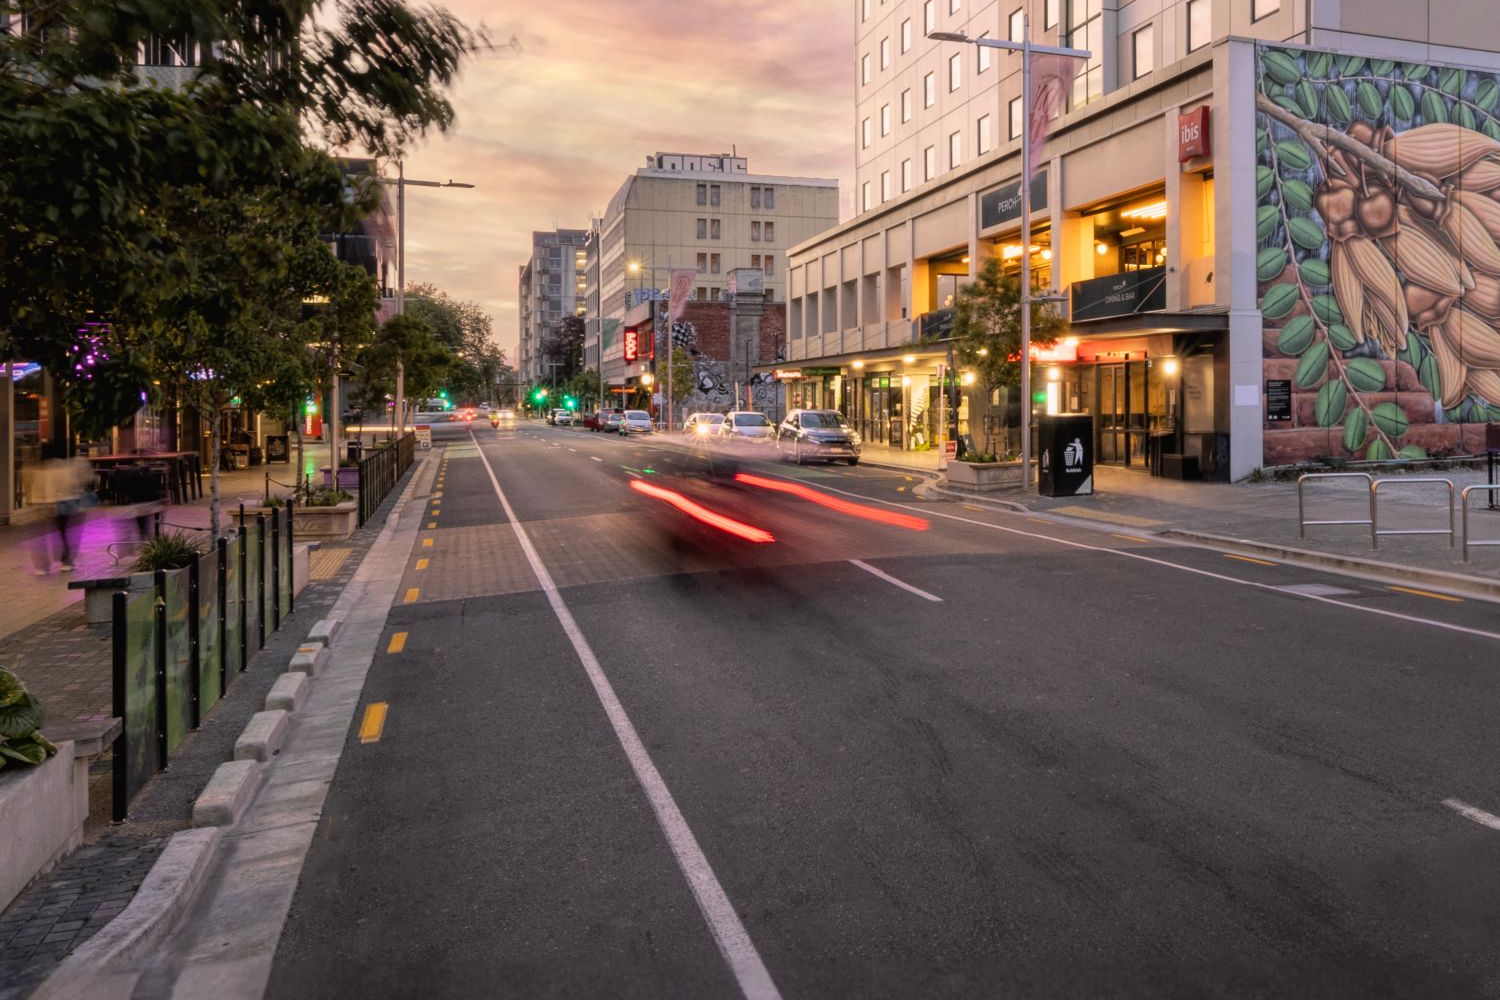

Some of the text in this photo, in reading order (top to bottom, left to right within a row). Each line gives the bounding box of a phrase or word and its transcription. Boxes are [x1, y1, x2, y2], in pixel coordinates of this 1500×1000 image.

[1181, 122, 1199, 144] ibis
[998, 197, 1017, 214] PERCH
[1105, 294, 1121, 304] DINING
[1125, 291, 1136, 301] BAR
